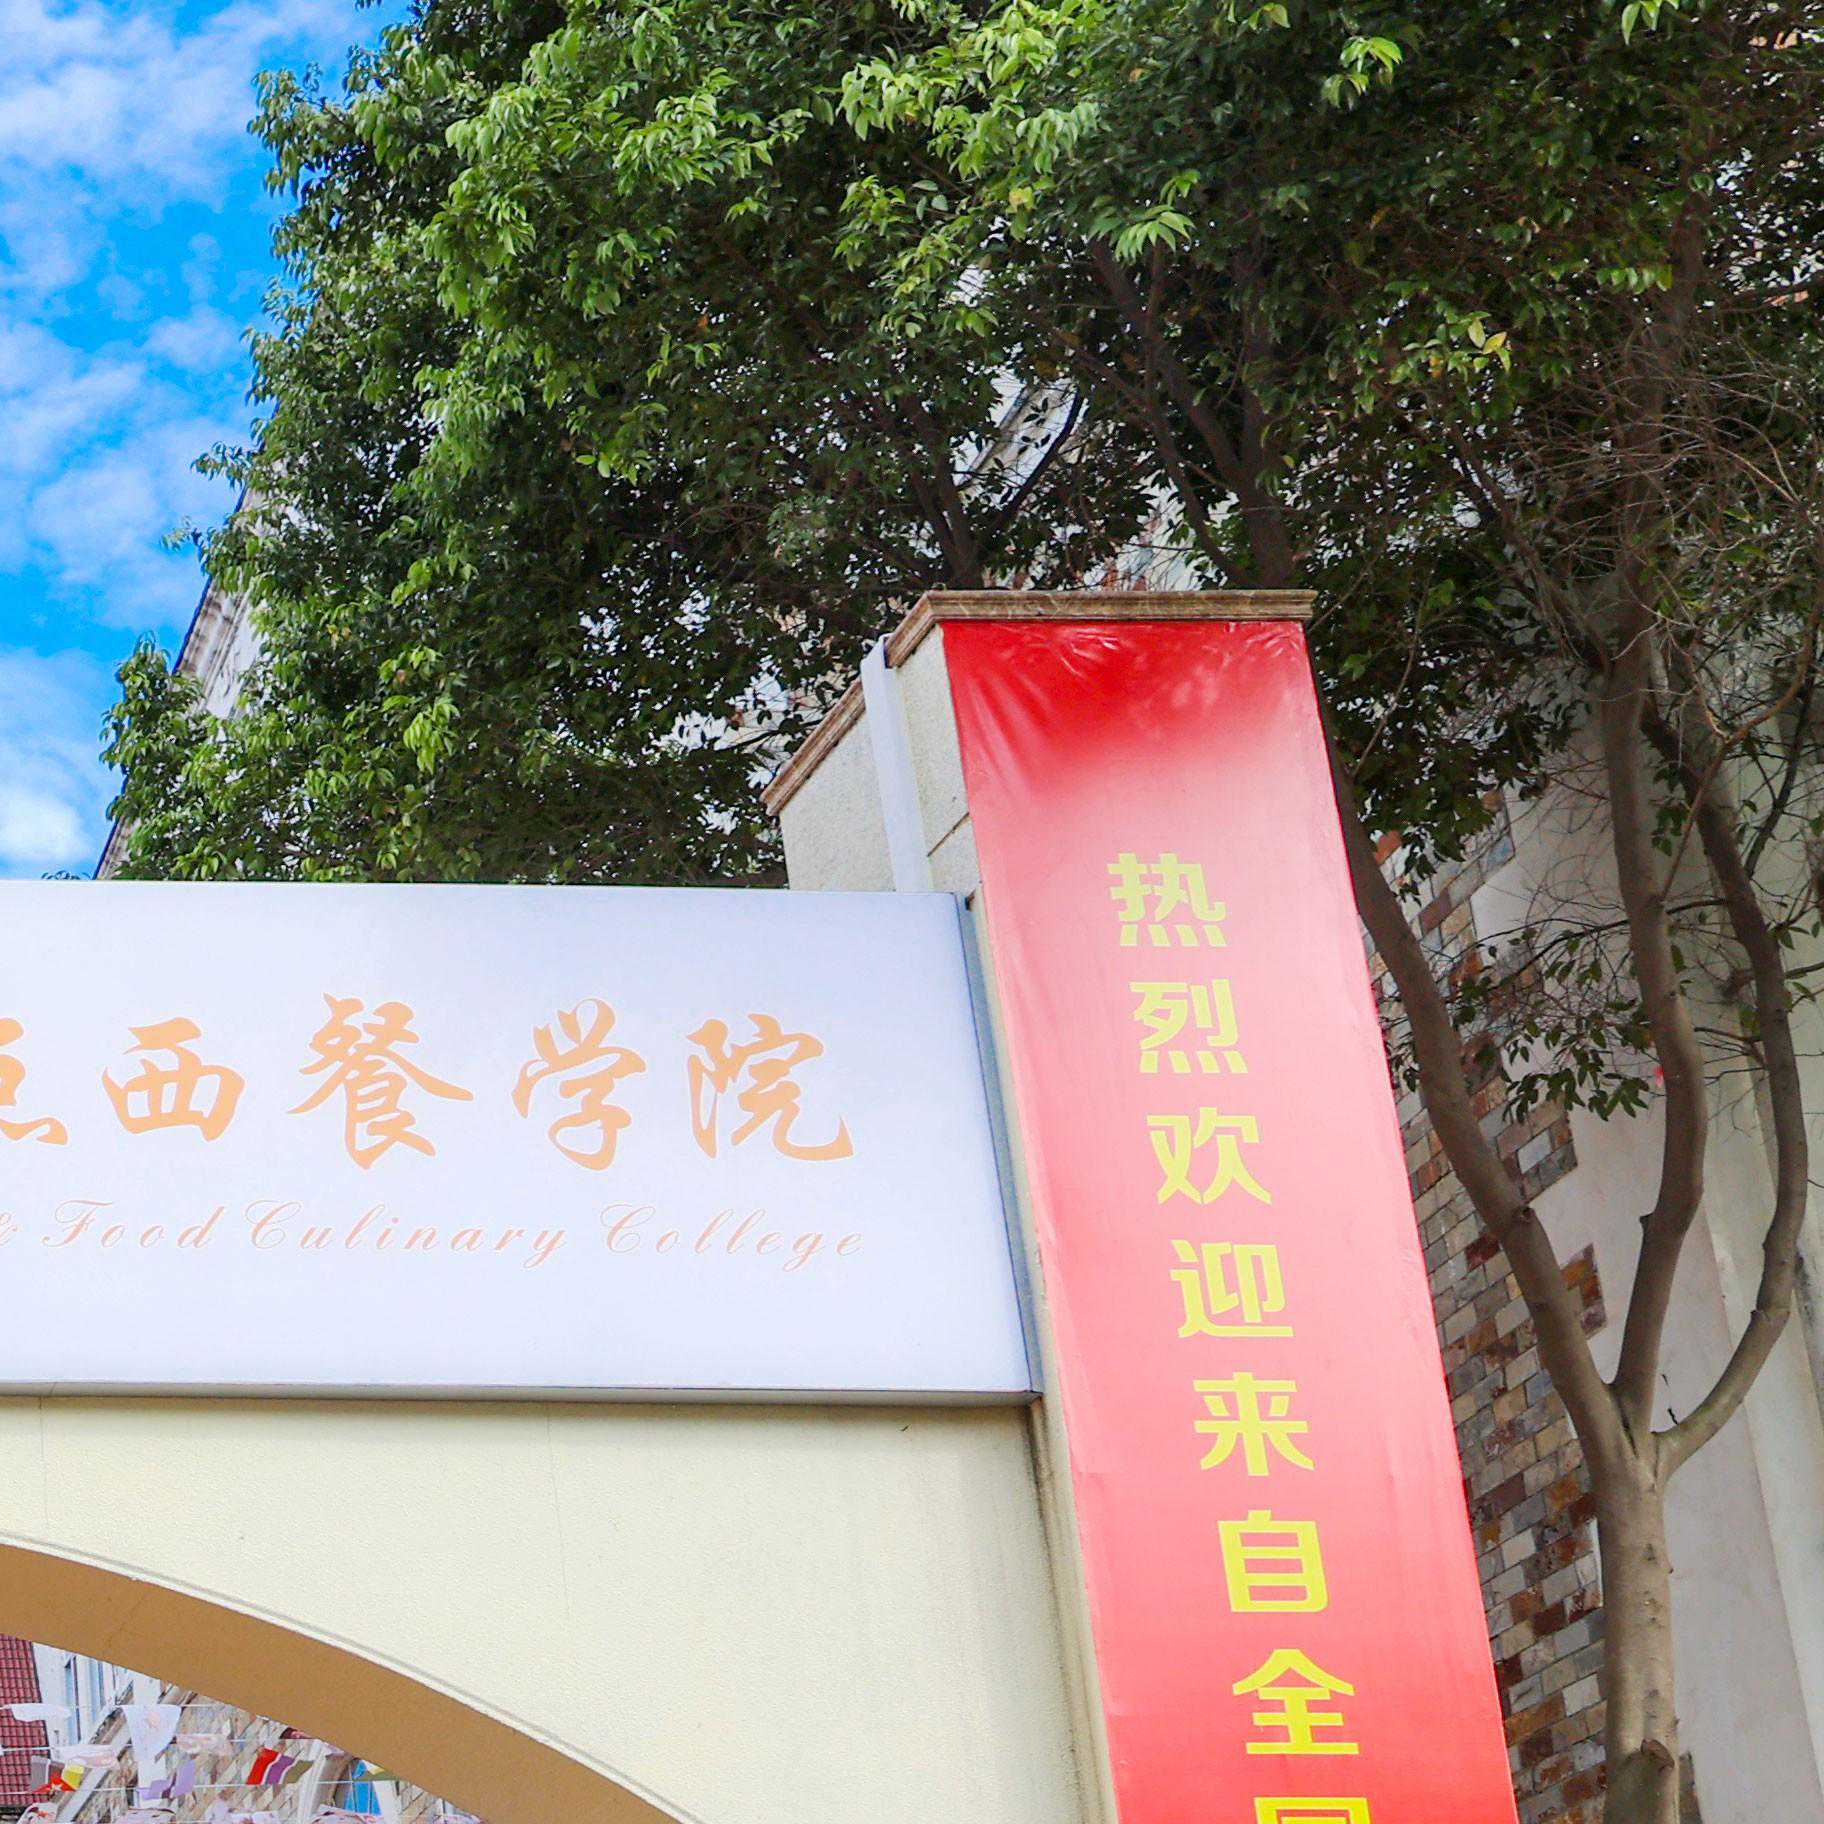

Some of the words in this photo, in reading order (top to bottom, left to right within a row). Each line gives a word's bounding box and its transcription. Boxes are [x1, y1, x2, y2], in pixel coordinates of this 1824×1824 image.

[42, 1199, 227, 1249] Food
[242, 1200, 570, 1270] Culinary
[599, 1204, 865, 1272] College
